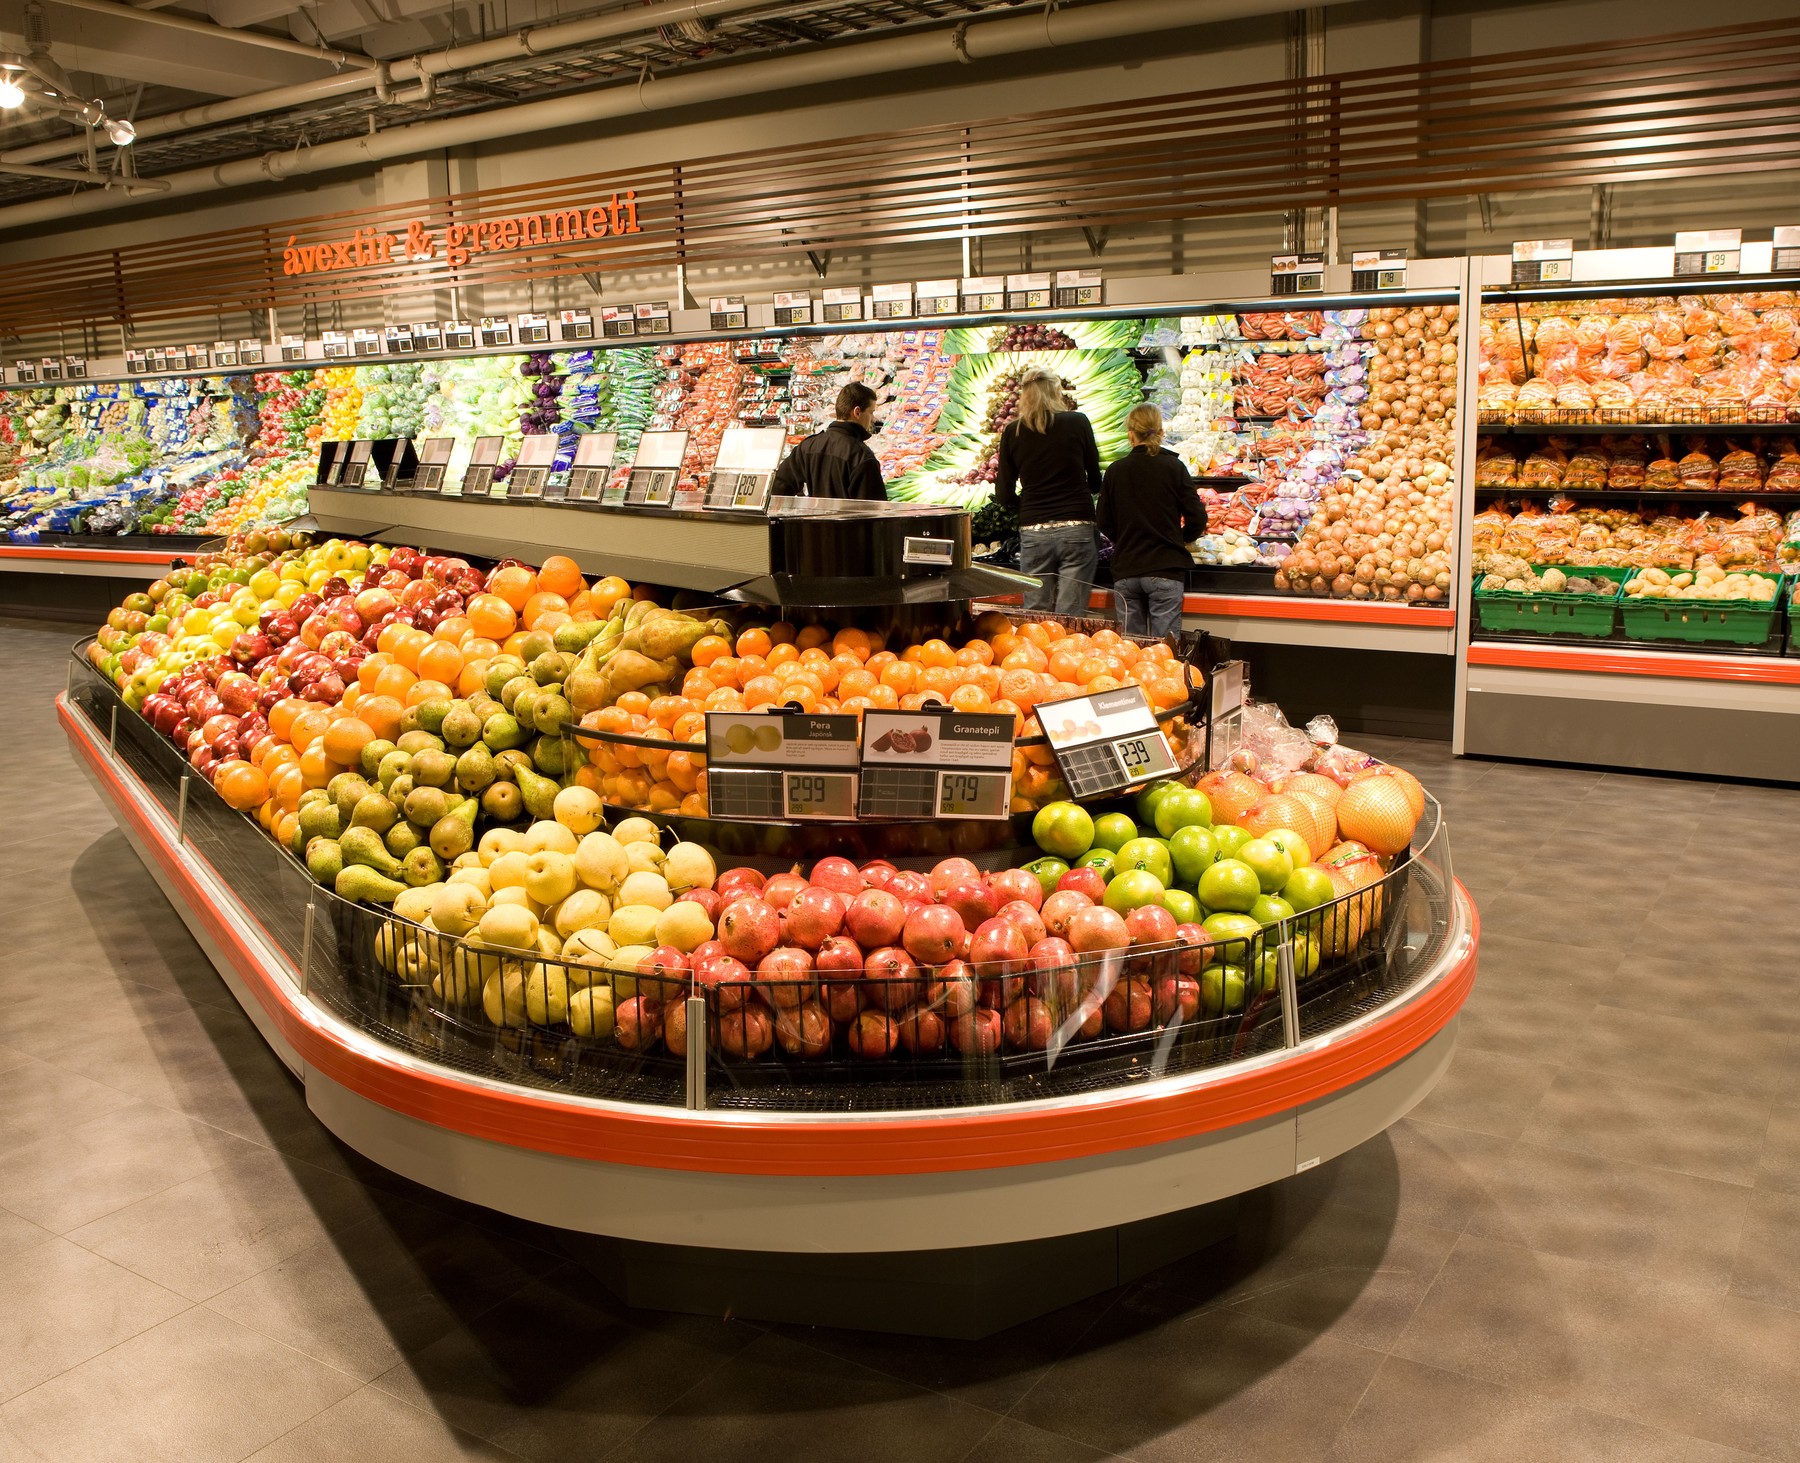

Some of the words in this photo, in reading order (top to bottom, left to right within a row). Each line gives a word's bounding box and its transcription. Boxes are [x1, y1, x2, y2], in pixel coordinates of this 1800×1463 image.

[283, 227, 398, 276] ávextir
[404, 220, 436, 261] &
[445, 190, 642, 267] grænmeti
[738, 475, 757, 496] 209
[810, 720, 831, 730] Pera
[953, 724, 1000, 737] Granatepli
[1118, 740, 1151, 767] 239
[790, 776, 825, 803] 299
[942, 775, 979, 802] 579
[942, 803, 955, 812] 579
